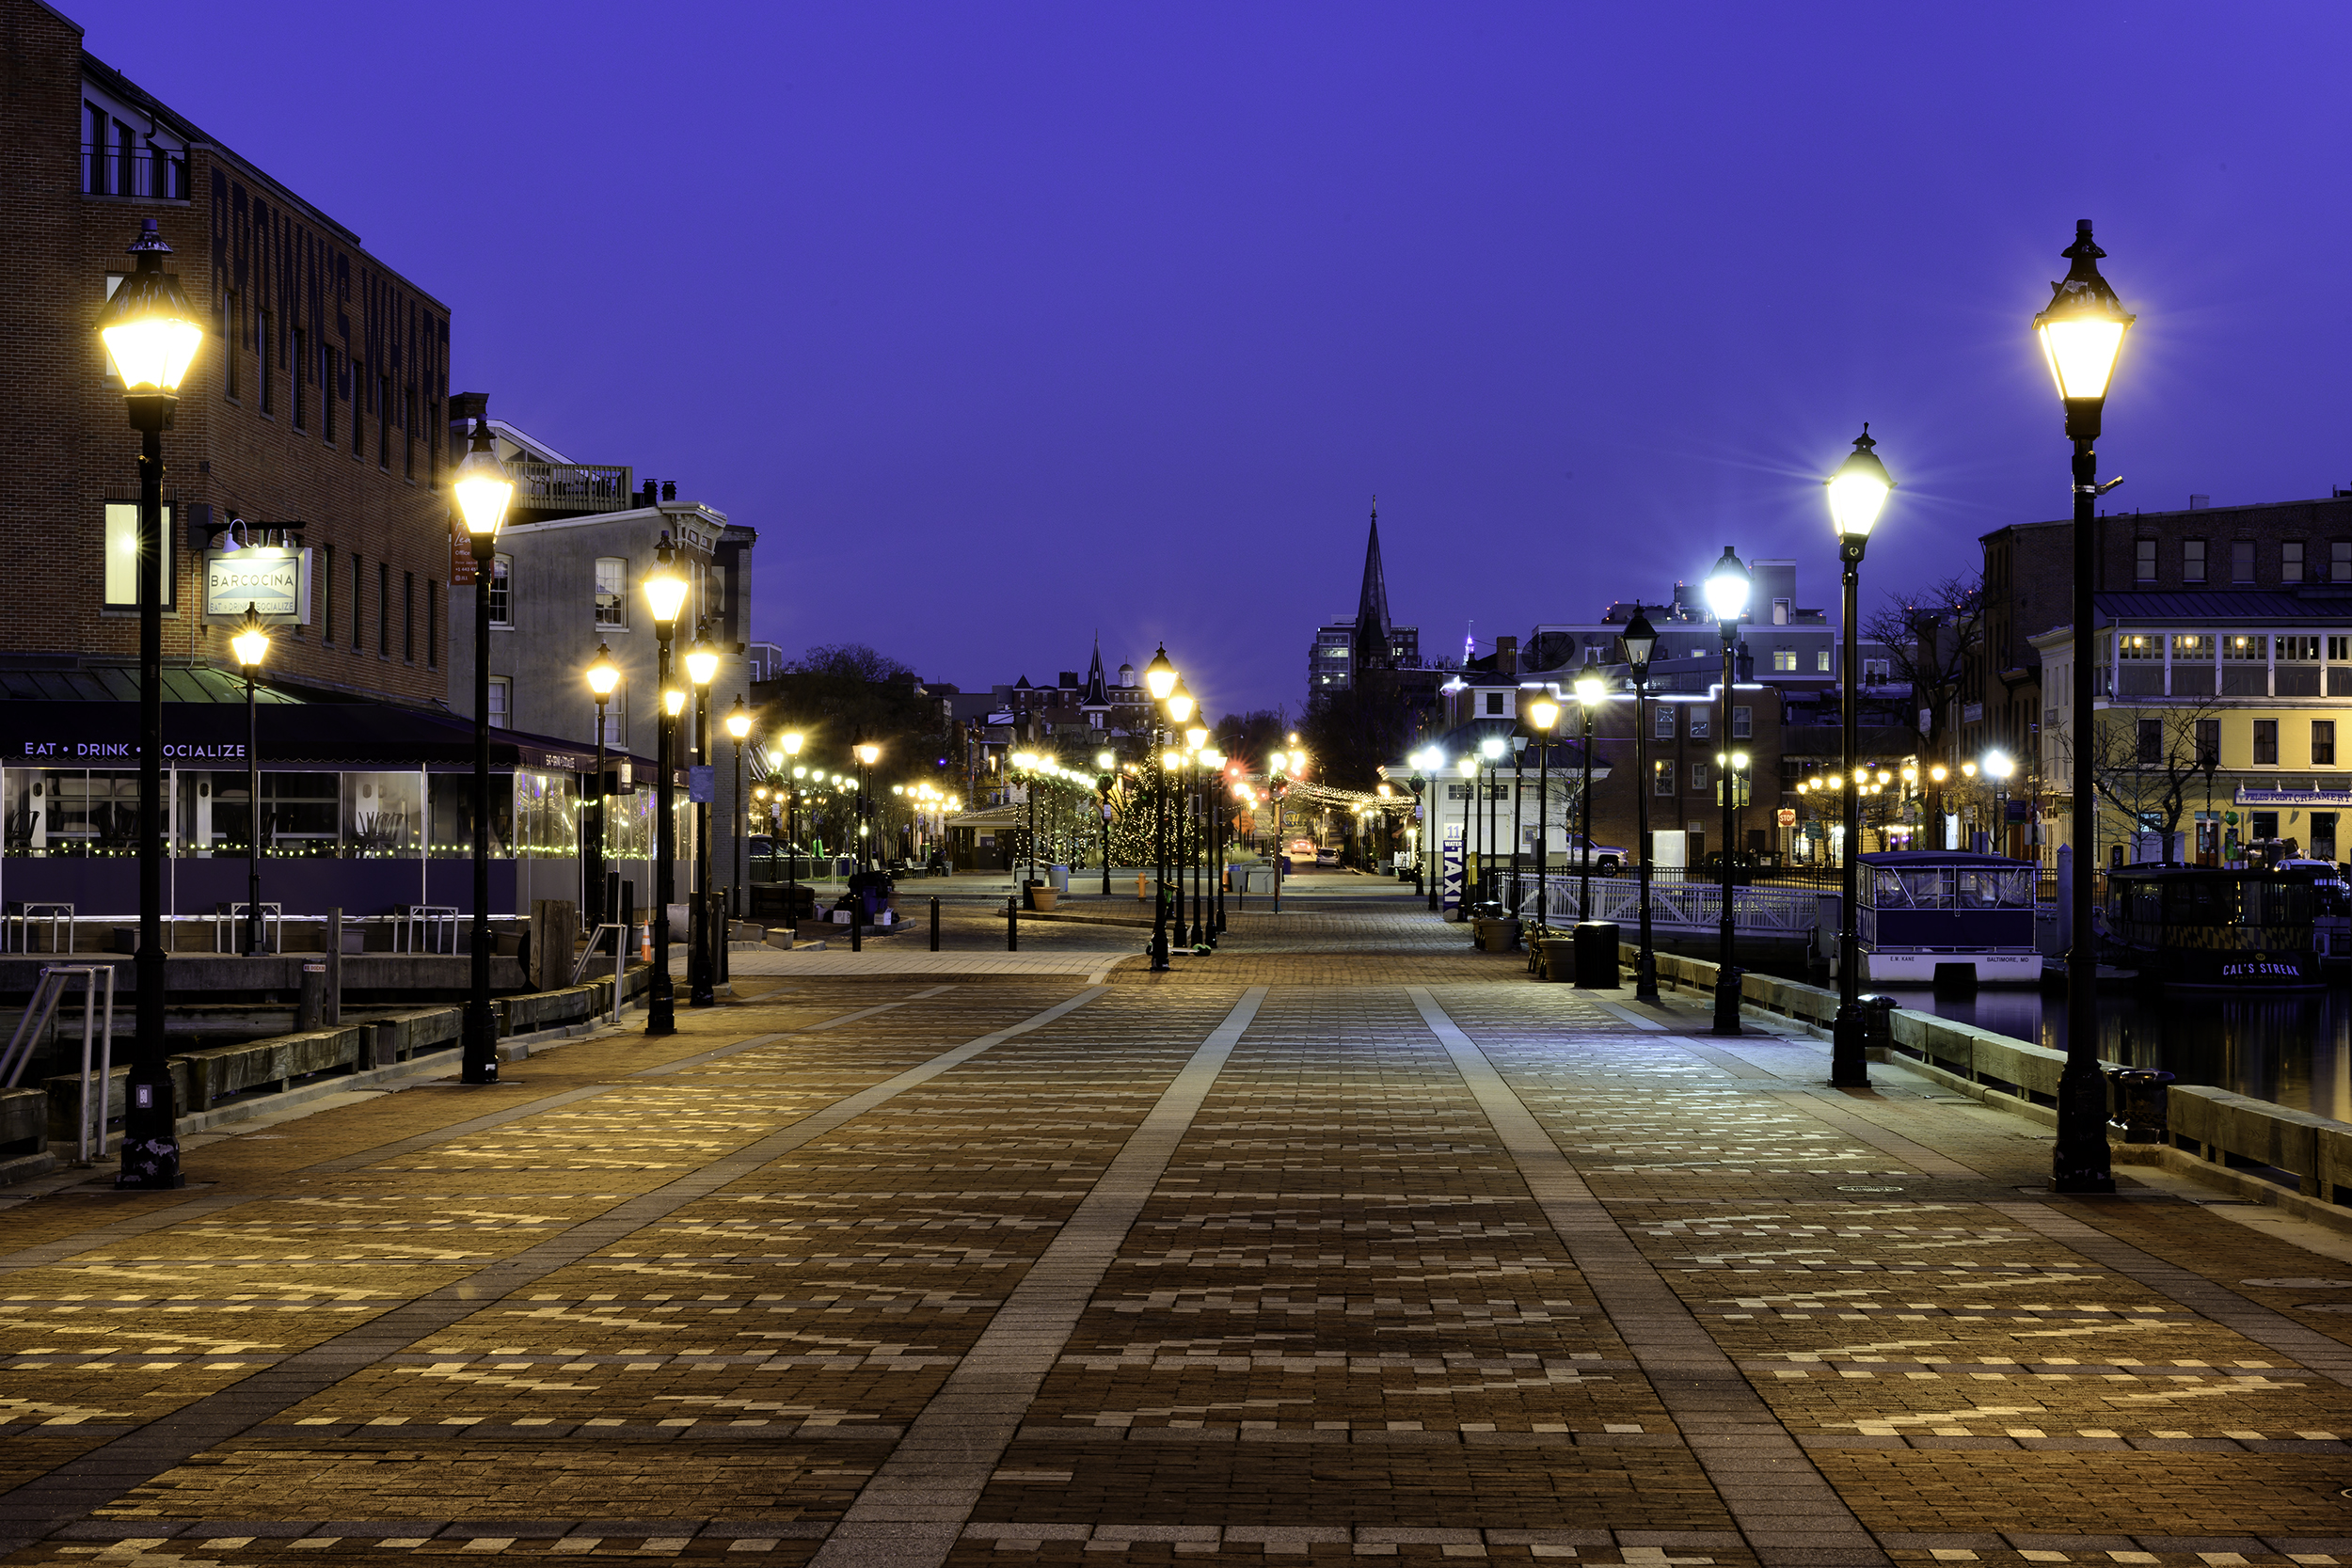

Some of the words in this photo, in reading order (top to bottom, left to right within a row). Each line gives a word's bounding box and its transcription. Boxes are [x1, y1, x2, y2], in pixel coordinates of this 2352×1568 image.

[211, 165, 351, 403] BROWN'S
[361, 266, 449, 450] WHARF
[454, 531, 471, 546] Lea
[211, 575, 294, 587] BARCOCINA
[210, 603, 222, 612] EAT
[256, 602, 294, 611] SOCIALIZE
[24, 742, 56, 755] EAT
[77, 743, 130, 756] DRINK
[163, 744, 246, 757] OCIALIZE
[2245, 793, 2269, 801] FELL'S
[2270, 793, 2293, 801] POINT
[2294, 792, 2351, 803] CREAMERY
[1447, 825, 1460, 838] 11
[1444, 847, 1462, 902] TAXI
[2223, 963, 2254, 975] CAL'S
[2260, 963, 2299, 976] STREAK
